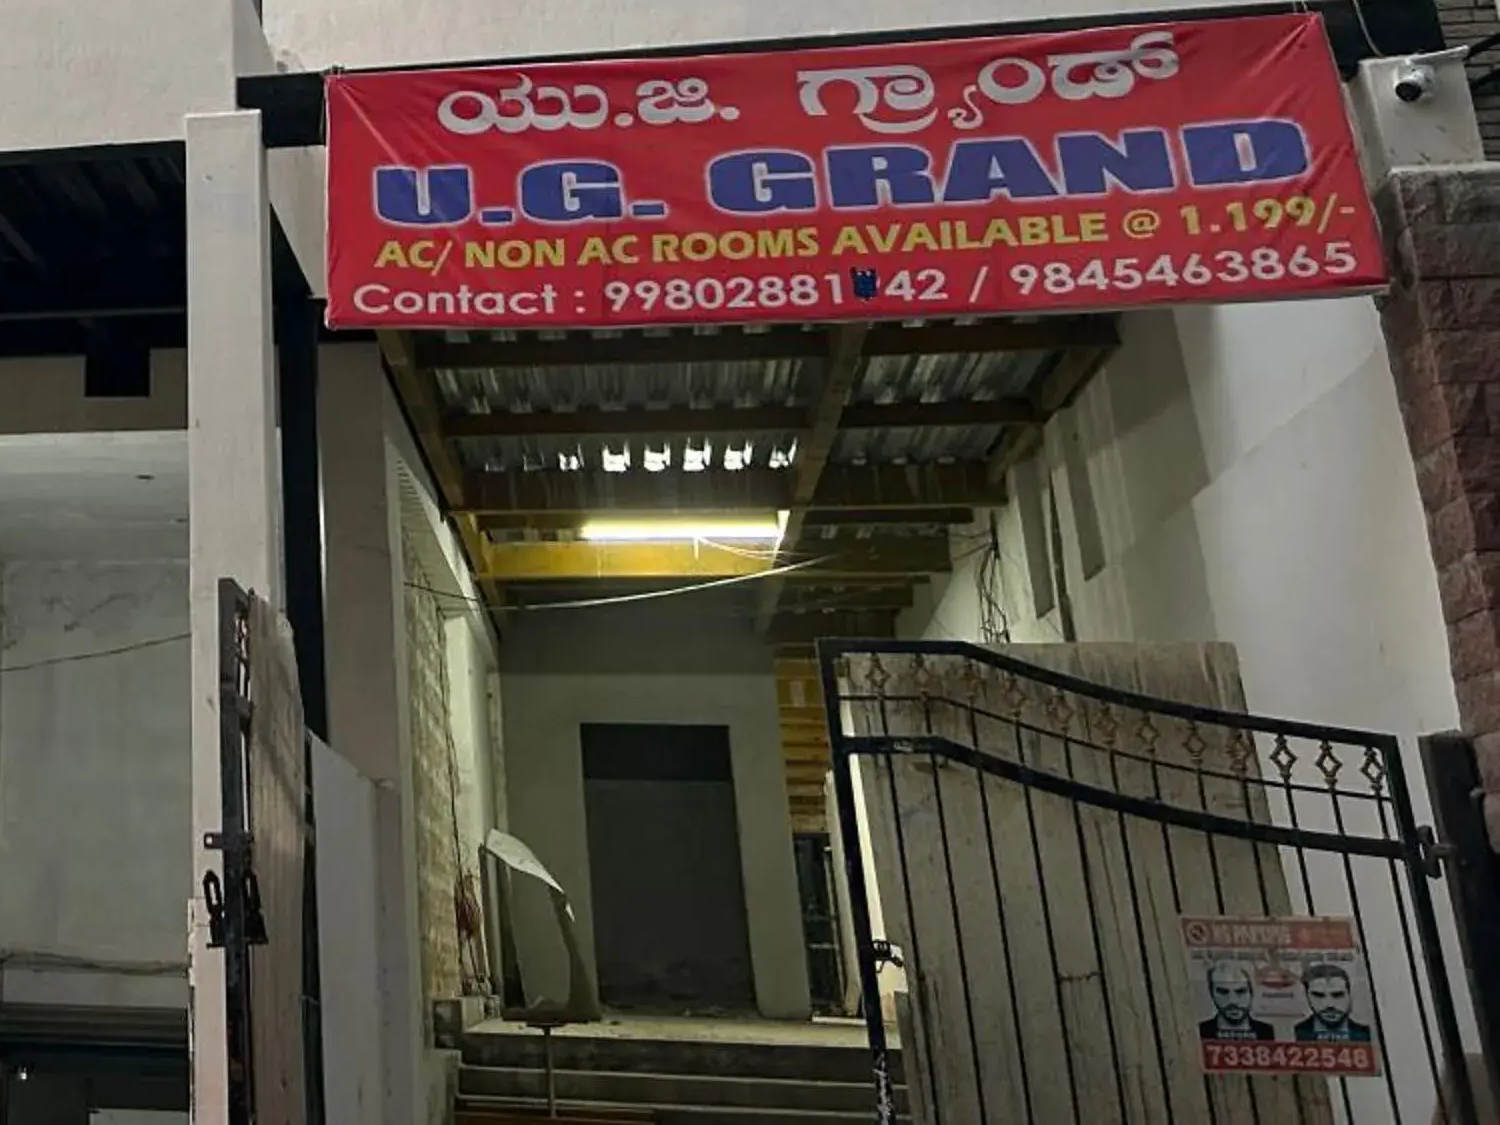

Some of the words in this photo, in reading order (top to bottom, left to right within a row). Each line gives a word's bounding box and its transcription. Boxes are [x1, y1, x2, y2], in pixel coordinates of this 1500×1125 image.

[373, 159, 670, 226] U.G.
[705, 117, 1312, 217] GRAND
[374, 239, 454, 276] AC/
[464, 238, 566, 268] NON
[577, 233, 640, 266] AC
[652, 226, 819, 262] ROOMS
[831, 212, 1109, 256] AVAILABLE
[1123, 208, 1161, 239] @
[353, 283, 559, 316] Contact
[604, 267, 949, 313] 9980288142
[1009, 241, 1358, 295] 9845463865
[1206, 1045, 1369, 1069] 7338422548
